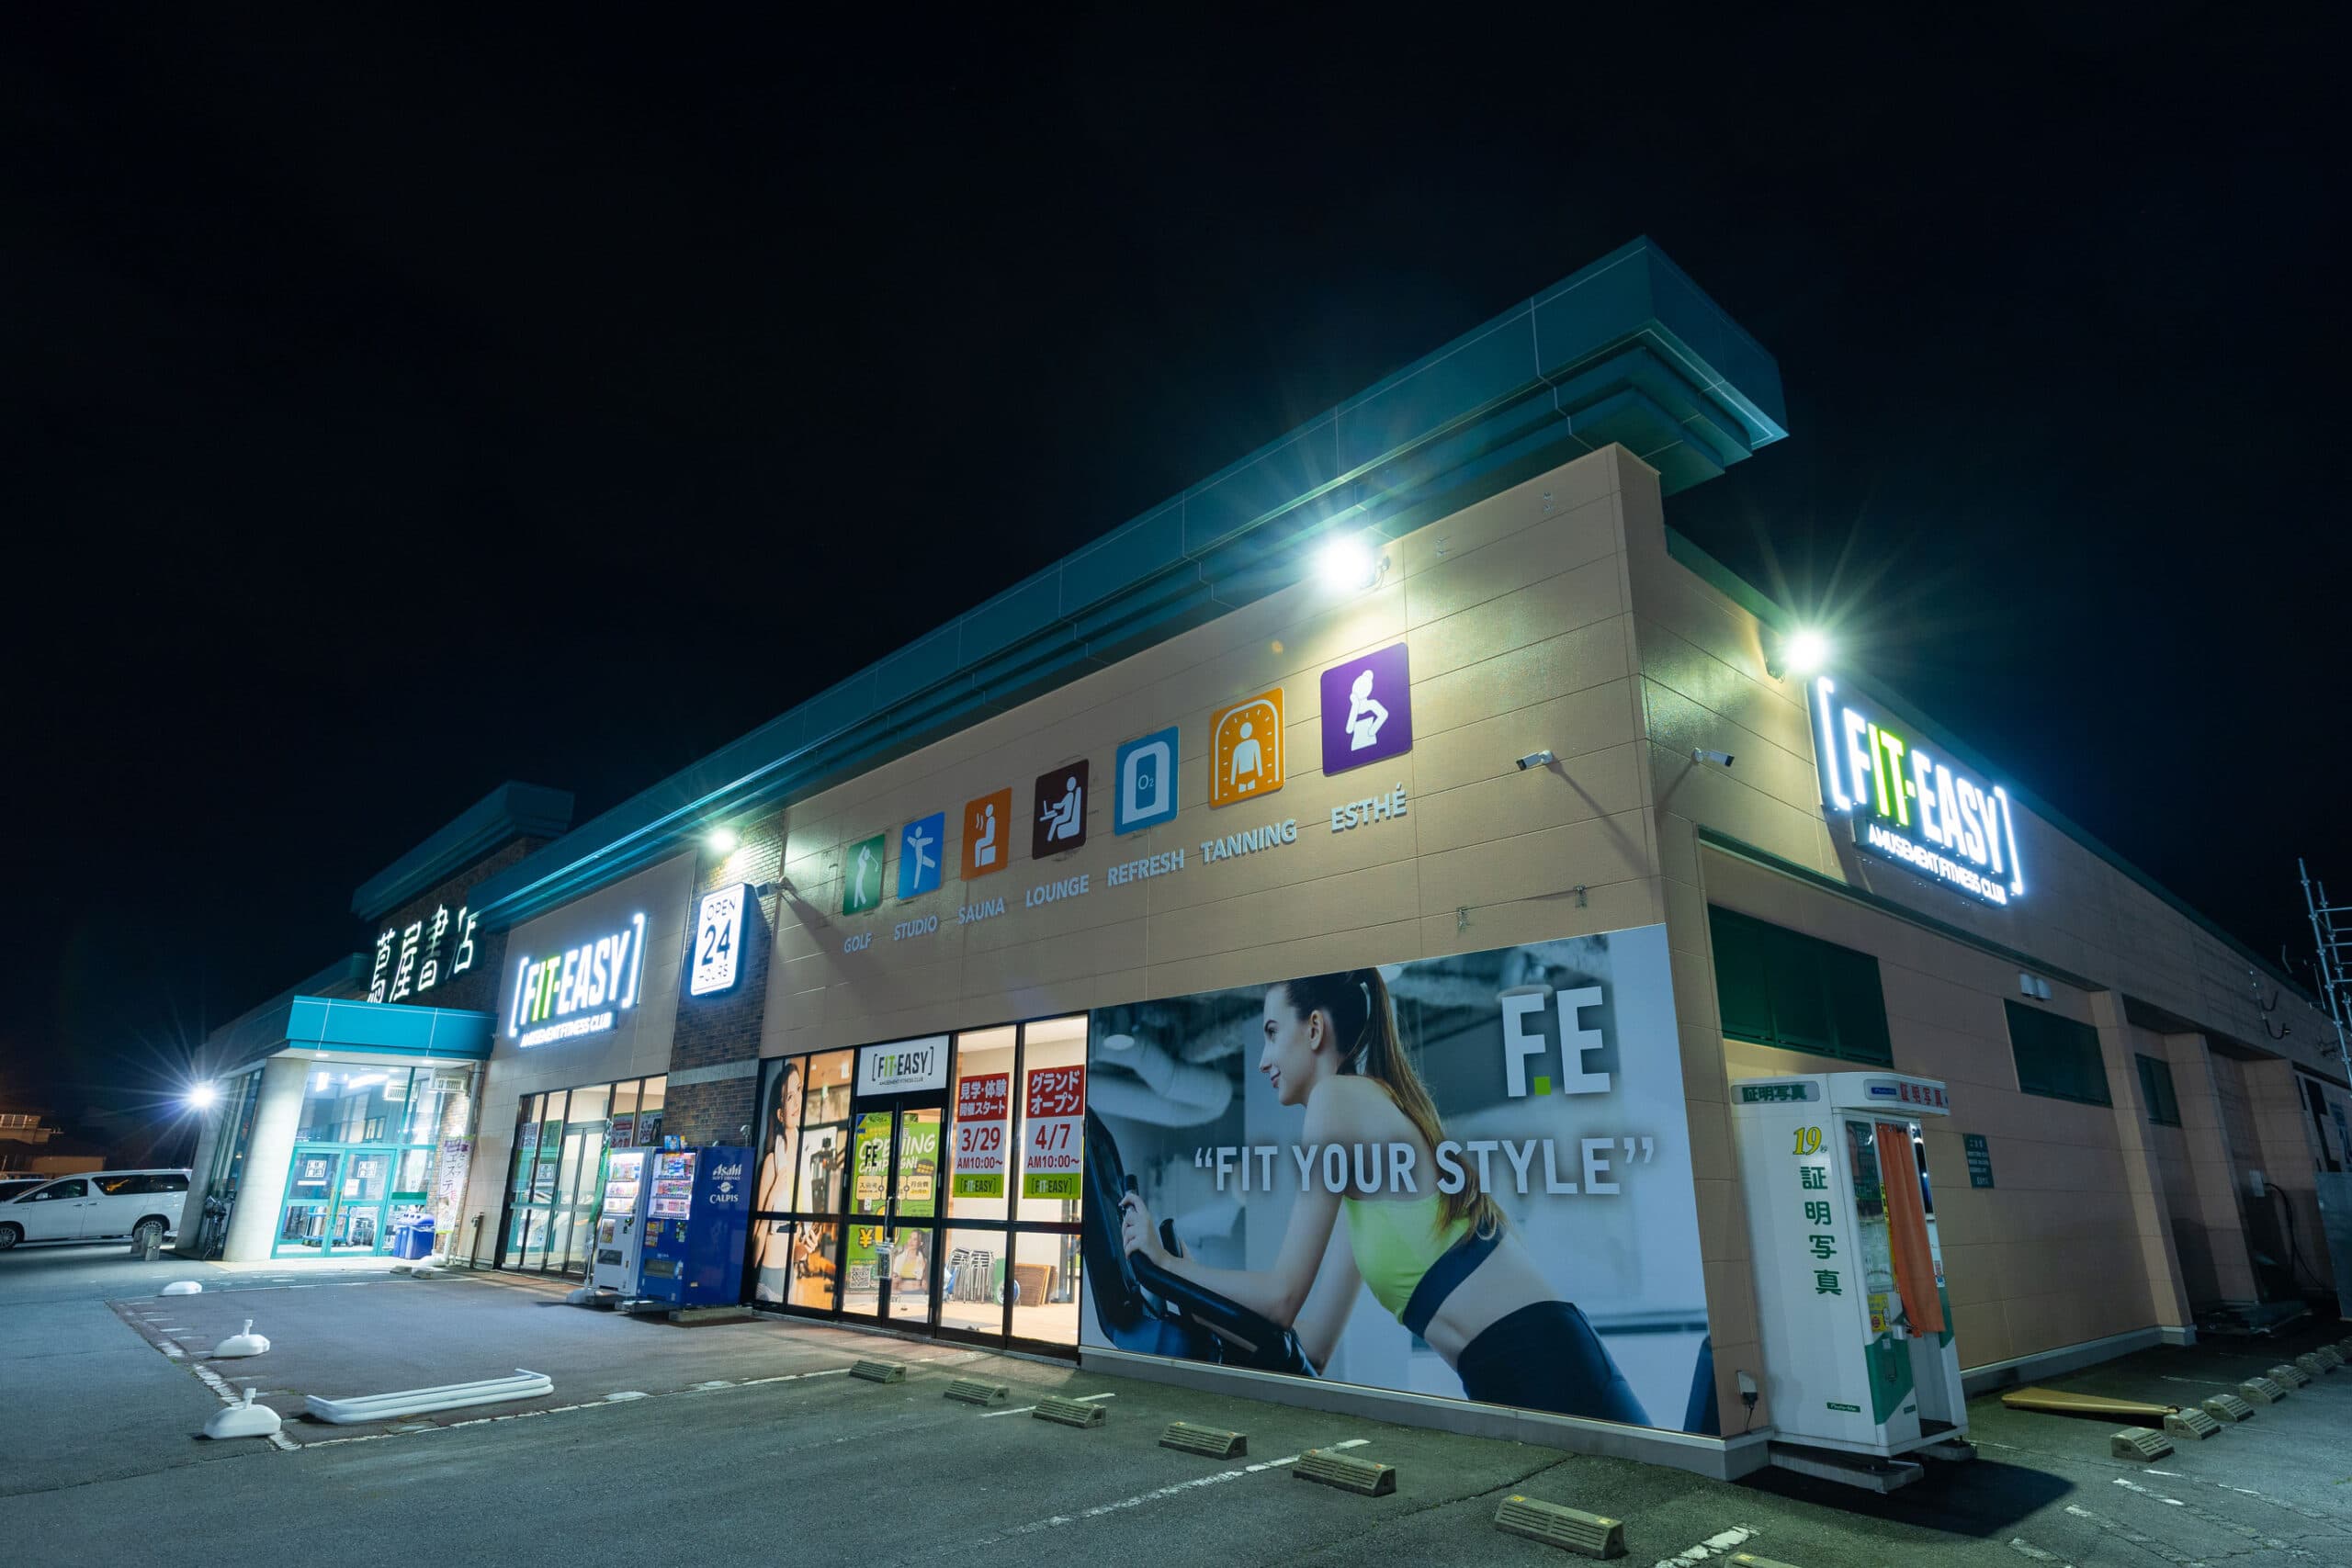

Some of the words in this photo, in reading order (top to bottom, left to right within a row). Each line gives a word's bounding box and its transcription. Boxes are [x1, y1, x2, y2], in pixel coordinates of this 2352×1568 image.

[1331, 782, 1408, 834] ESTHÉ
[1200, 818, 1297, 864] TANNING
[1107, 848, 1185, 887] REFRESH
[1026, 874, 1090, 908] LOUNGE
[707, 897, 736, 920] OPEN
[957, 897, 1005, 925] SAUNA
[894, 915, 938, 941] STUDIO
[702, 919, 731, 966] 24
[843, 932, 872, 953] GOLF
[1031, 1069, 1080, 1095] グランド
[1742, 1084, 1807, 1103] 証明写真
[959, 1100, 1006, 1117] 開催スタート
[1030, 1092, 1080, 1114] オープン
[961, 1127, 1001, 1153] 3/29
[1035, 1123, 1071, 1151] 4/7
[712, 1163, 742, 1177] Asahi
[1293, 1143, 1417, 1194] YOUR
[709, 1193, 739, 1204] CALPIS
[1800, 1166, 1842, 1296] 証明写真
